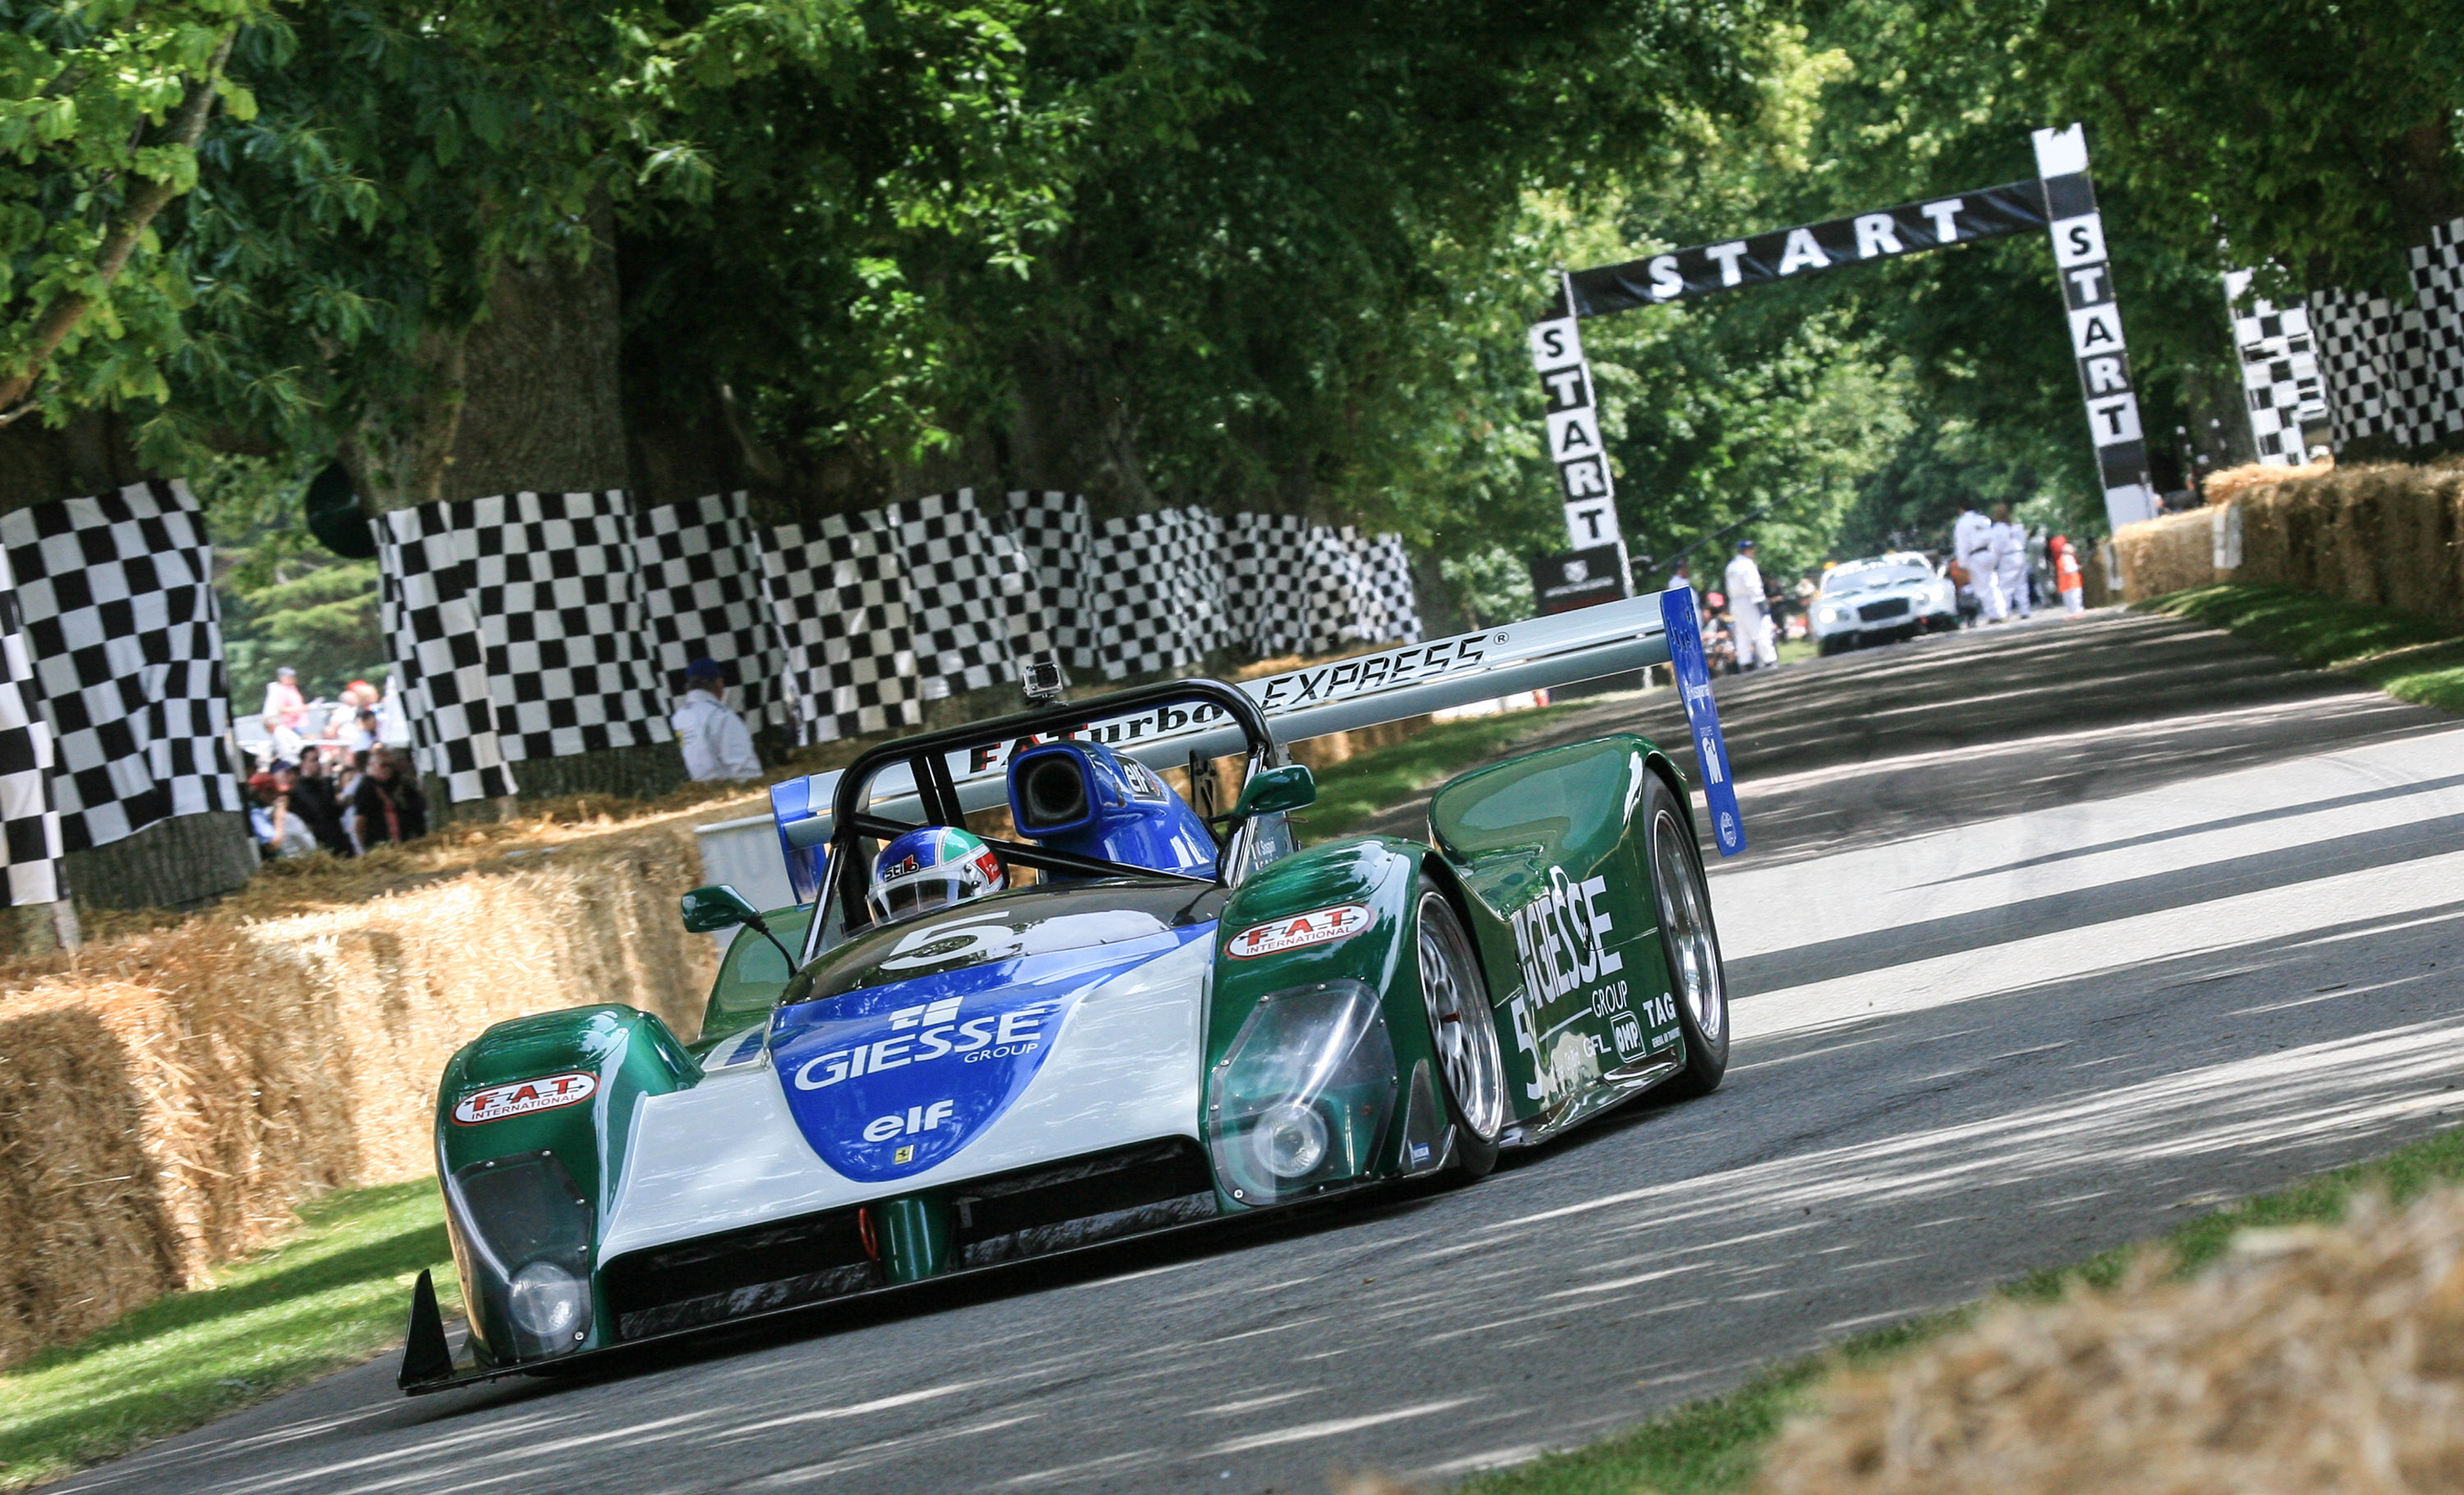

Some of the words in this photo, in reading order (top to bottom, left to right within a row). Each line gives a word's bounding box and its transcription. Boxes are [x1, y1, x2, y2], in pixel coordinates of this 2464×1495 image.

[1648, 198, 1965, 301] START
[2069, 226, 2127, 435] START
[1542, 329, 1606, 539] START
[1262, 634, 1488, 710] EXPRESS
[1124, 762, 1150, 793] elf
[880, 910, 1015, 971] 5
[1245, 925, 1354, 954] INTERNATIONAL
[1591, 979, 1628, 1018] GROUP
[1642, 991, 1677, 1028] TAG
[794, 1008, 1046, 1091] GIESSE
[963, 1042, 1039, 1064] GROUP
[471, 1093, 577, 1120] INTERNATIONAL
[862, 1099, 954, 1143] elf
